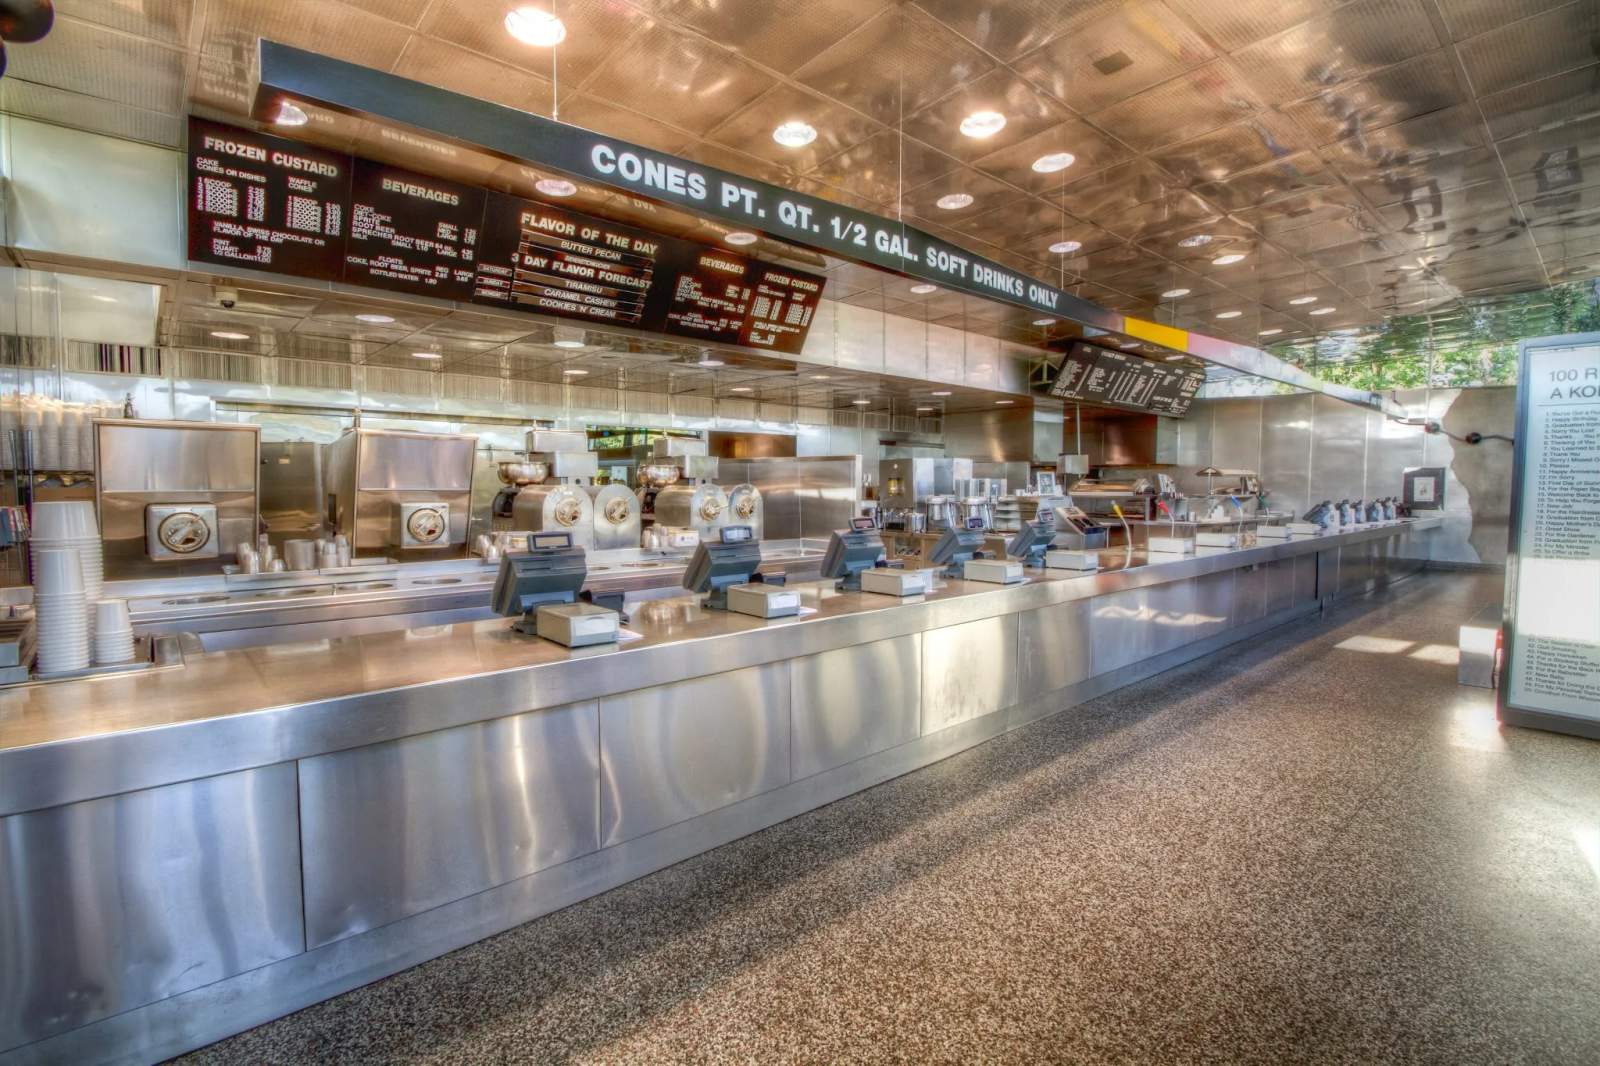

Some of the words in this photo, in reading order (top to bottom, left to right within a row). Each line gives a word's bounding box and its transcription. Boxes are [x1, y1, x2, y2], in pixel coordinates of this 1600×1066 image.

[196, 157, 219, 167] CAKE
[204, 136, 266, 161] FROZEN
[272, 152, 338, 177] CUSTARD
[196, 163, 224, 174] CONES
[239, 171, 266, 182] DISHES
[288, 176, 317, 188] WAFFLE
[382, 178, 459, 206] BEVERAGES
[354, 204, 374, 213] COKE
[352, 221, 374, 230] ROOT
[376, 225, 396, 234] BEER
[521, 213, 575, 235] FLAVOR
[581, 228, 600, 240] OF
[605, 233, 629, 248] THE
[634, 239, 658, 255] DAY
[591, 144, 707, 200] CONES
[721, 182, 765, 218] PT.
[778, 201, 819, 233] QT.
[831, 217, 867, 246] 1/2
[875, 230, 918, 262] GAL.
[926, 246, 968, 277] SOFT
[973, 266, 1024, 297] DRINKS
[1029, 284, 1058, 308] ONLY
[272, 231, 313, 244] CHOCOLATE
[352, 227, 393, 240] SPRECHER
[394, 234, 415, 243] ROOT
[416, 239, 434, 248] BEER
[561, 240, 593, 255] BUTTER
[595, 248, 622, 261] PECAN
[370, 260, 388, 269] ROOT
[511, 252, 519, 263] 3
[524, 255, 548, 270] DAY
[552, 261, 594, 278] FLAVOR
[599, 271, 652, 289] FORECAST
[700, 256, 745, 274] BEVERAGES
[565, 280, 603, 294] TIRAMISU
[765, 272, 789, 286] FROZEN
[791, 278, 819, 291] CUSTARD
[544, 288, 582, 301] CARAMEL
[585, 296, 618, 308] CASHEW
[539, 298, 577, 312] COOKIES
[590, 307, 616, 319] CREAM
[1550, 369, 1578, 382] 100
[1550, 387, 1562, 399] A
[1569, 385, 1600, 399] KO
